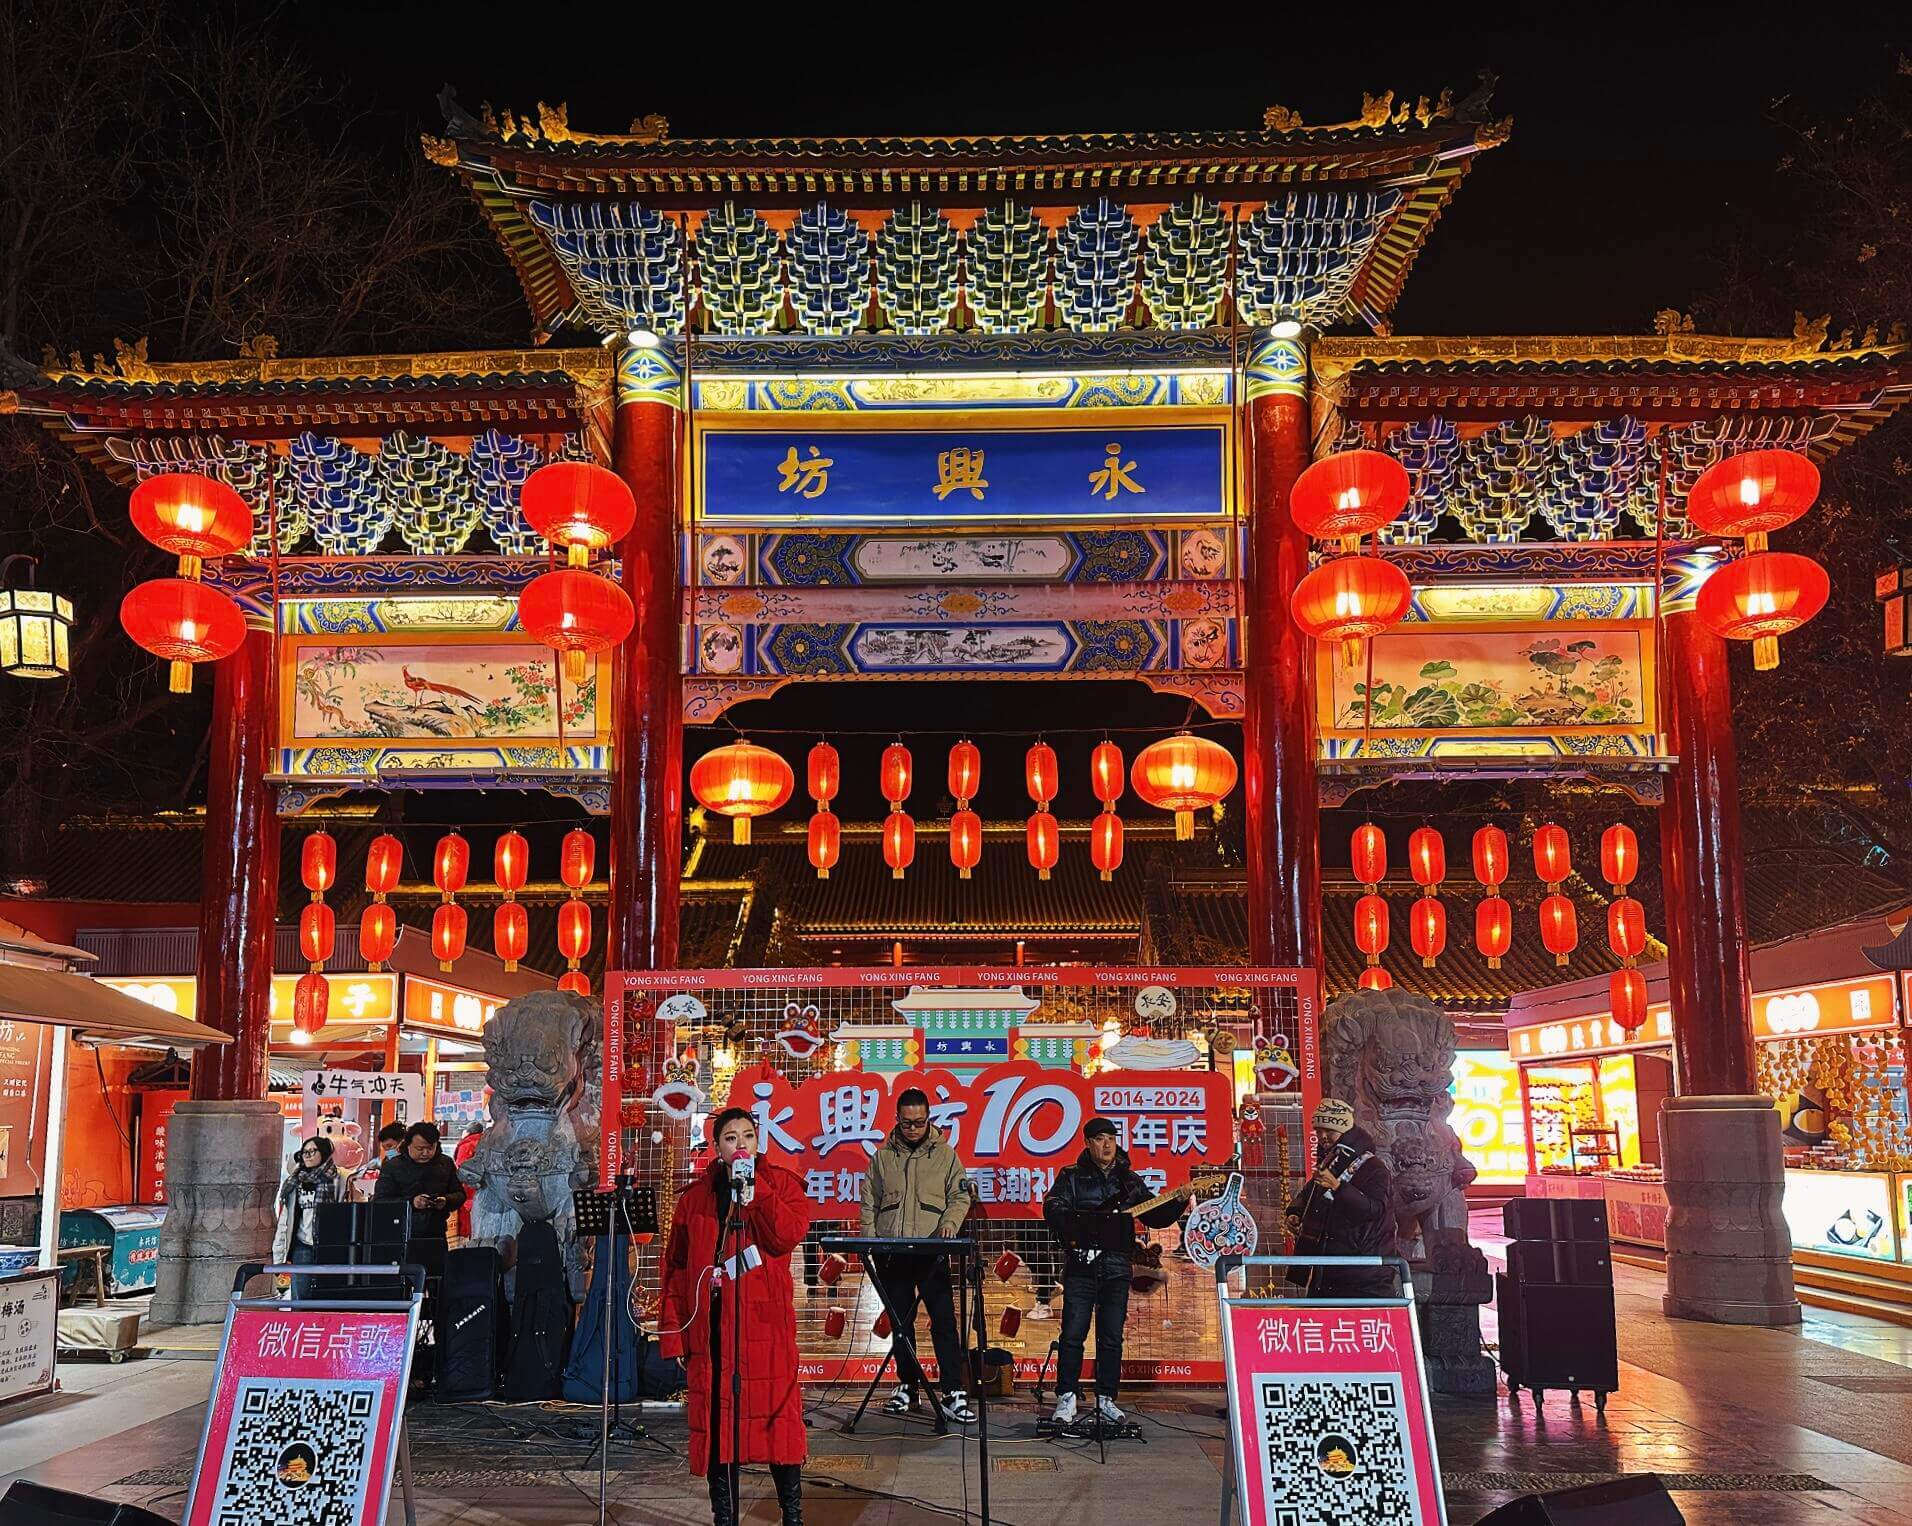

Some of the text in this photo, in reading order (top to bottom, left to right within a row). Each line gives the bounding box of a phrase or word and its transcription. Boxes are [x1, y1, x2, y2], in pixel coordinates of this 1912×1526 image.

[624, 975, 705, 985] YONG XING FANG
[743, 974, 822, 983] YONG XING FANG
[860, 973, 939, 981] YONG XING FANG
[977, 972, 1057, 981] YONG XING FANG
[1096, 972, 1176, 981] YONG XING FANG
[1215, 973, 1297, 982] YONG XING FANG
[609, 1000, 620, 1081] YONG XING FANG
[1303, 997, 1315, 1079] YONG XING FANG
[329, 1074, 405, 1095] 牛气冲天
[1100, 1090, 1200, 1107] 2014-2024
[974, 1076, 1082, 1156] 10
[607, 1131, 618, 1188] YONG XING
[0, 1299, 25, 1319] 梅汤
[257, 1321, 391, 1360] 微信点歌
[1256, 1318, 1396, 1354] 微信点歌
[797, 1365, 824, 1375] FANG
[1165, 1366, 1191, 1376] FANG
